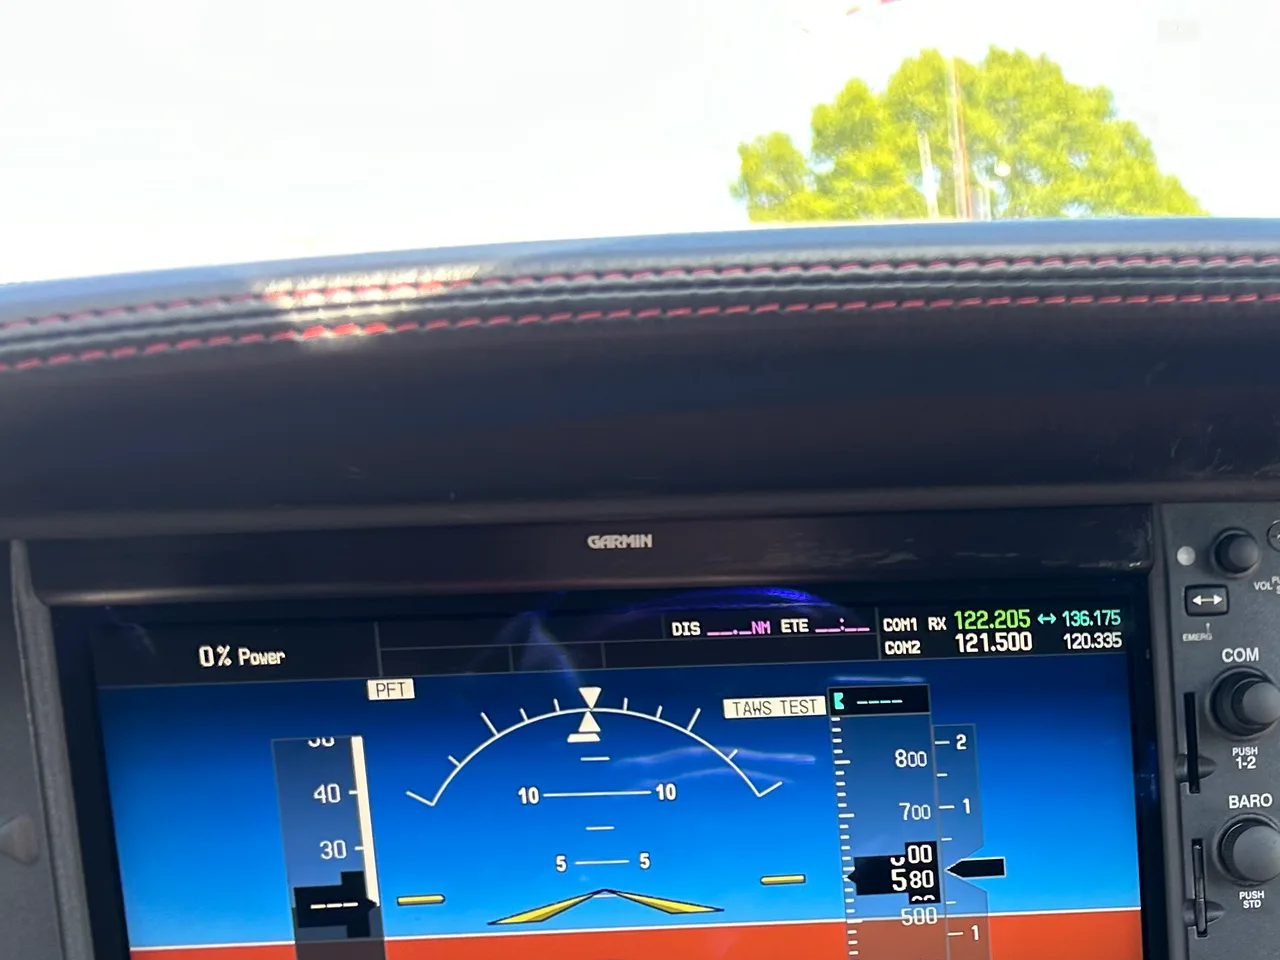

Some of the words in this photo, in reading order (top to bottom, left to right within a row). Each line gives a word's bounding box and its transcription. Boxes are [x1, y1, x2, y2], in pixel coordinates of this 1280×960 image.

[587, 534, 653, 549] GARMIN
[672, 622, 701, 636] DIS
[781, 618, 809, 632] ETE
[883, 618, 918, 631] COM1
[928, 616, 947, 630] RX
[954, 609, 1031, 630] 122.205
[1062, 609, 1121, 627] 136.175
[885, 641, 921, 655] COM2
[955, 631, 1033, 653] 121.500
[1063, 632, 1123, 649] 120.335
[239, 647, 286, 666] Power
[1222, 648, 1259, 662] COM
[375, 682, 406, 698] PFT
[733, 701, 771, 716] TAWS
[779, 699, 817, 714] TEST
[896, 749, 927, 767] 800
[313, 784, 341, 803] 40
[518, 787, 539, 804] 10
[656, 784, 676, 800] 10
[1228, 794, 1273, 809] BARO
[899, 802, 931, 820] 700
[319, 841, 347, 860] 30
